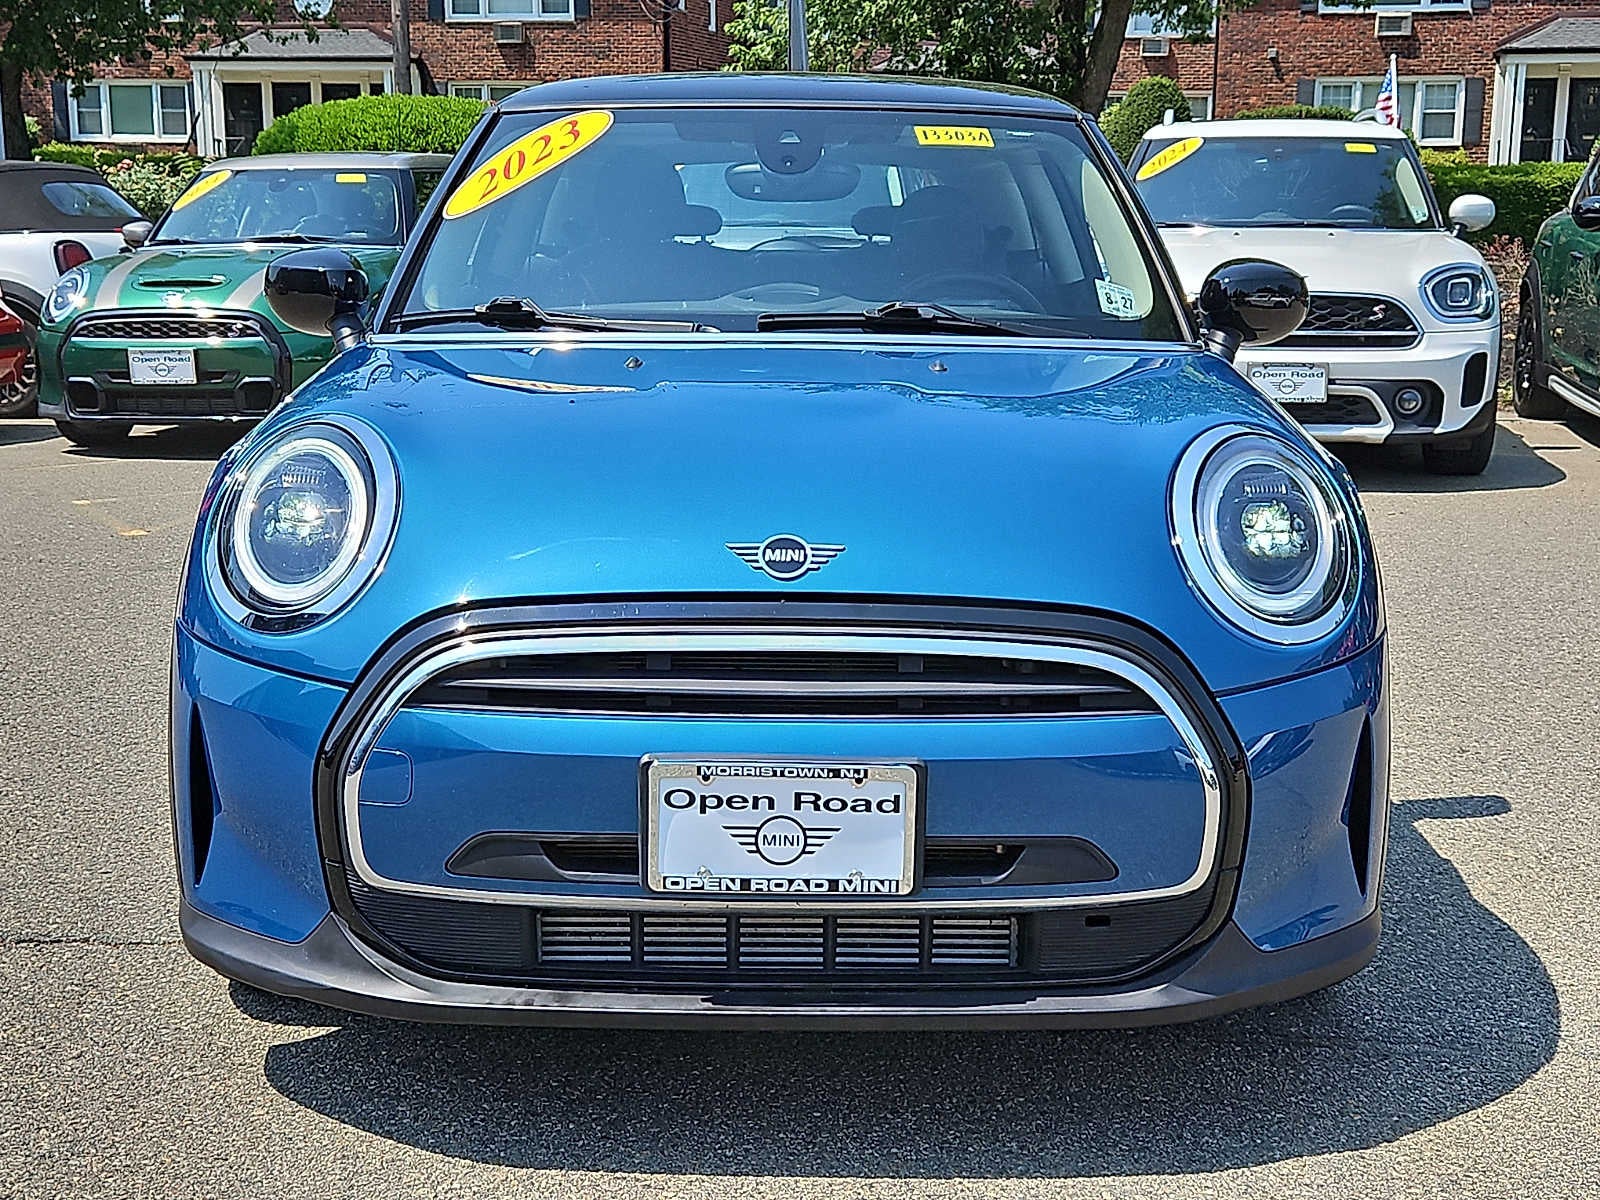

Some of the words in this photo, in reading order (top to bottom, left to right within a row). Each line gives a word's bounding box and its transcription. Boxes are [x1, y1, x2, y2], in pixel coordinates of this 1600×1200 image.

[478, 119, 581, 202] 2023
[1104, 292, 1114, 305] 8
[1120, 296, 1134, 311] 27
[1252, 370, 1287, 379] Open
[1290, 371, 1324, 379] Road
[764, 549, 805, 562] MINI
[700, 765, 834, 778] MORRISTOWN,
[840, 767, 865, 779] NJ
[663, 788, 776, 815] Open
[793, 791, 902, 814] Road
[761, 833, 801, 848] MINI
[665, 876, 742, 892] OPEN
[750, 878, 830, 893] ROAD
[838, 878, 898, 893] MINI
